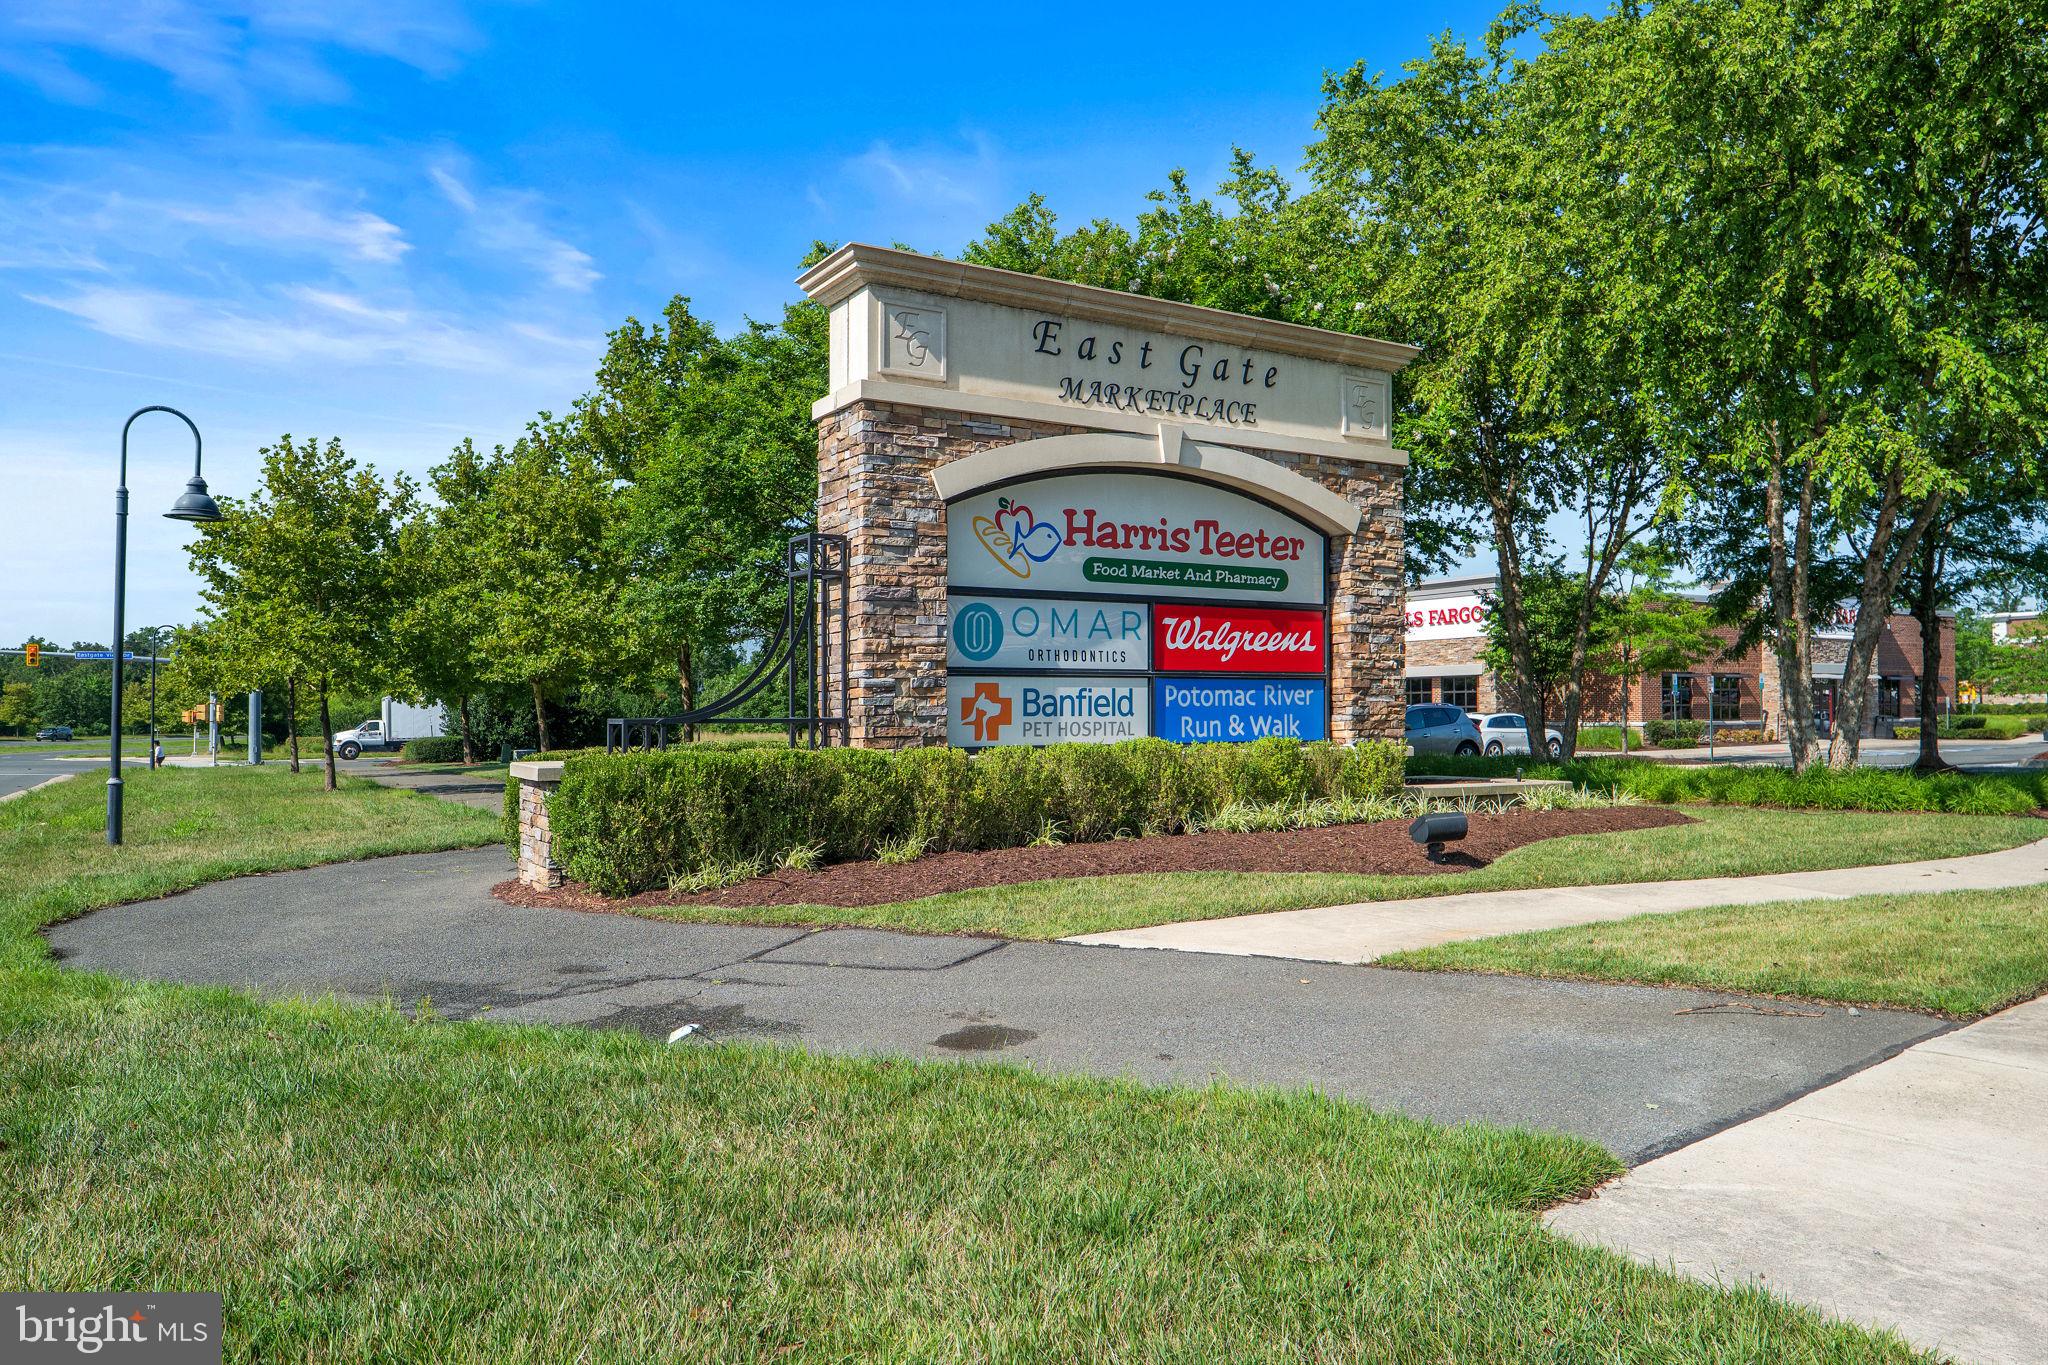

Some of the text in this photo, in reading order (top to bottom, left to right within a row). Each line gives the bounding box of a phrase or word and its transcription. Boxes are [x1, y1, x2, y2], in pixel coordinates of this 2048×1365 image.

[1032, 320, 1279, 388] East Gate
[1058, 377, 1258, 424] MARKETPLACE
[1062, 508, 1305, 561] Harris Teeter
[1092, 562, 1281, 589] Food Market And Pharmacy
[1011, 606, 1142, 641] OMAR
[1428, 605, 1485, 625] FARGO
[1161, 615, 1317, 662] Walgreens
[1028, 648, 1127, 663] ORTHODONTICS
[1022, 687, 1135, 718] Banfield
[1165, 684, 1314, 708] Potomac River
[1022, 721, 1135, 737] PET HOSPITAL
[1181, 713, 1301, 738] Run & Walk
